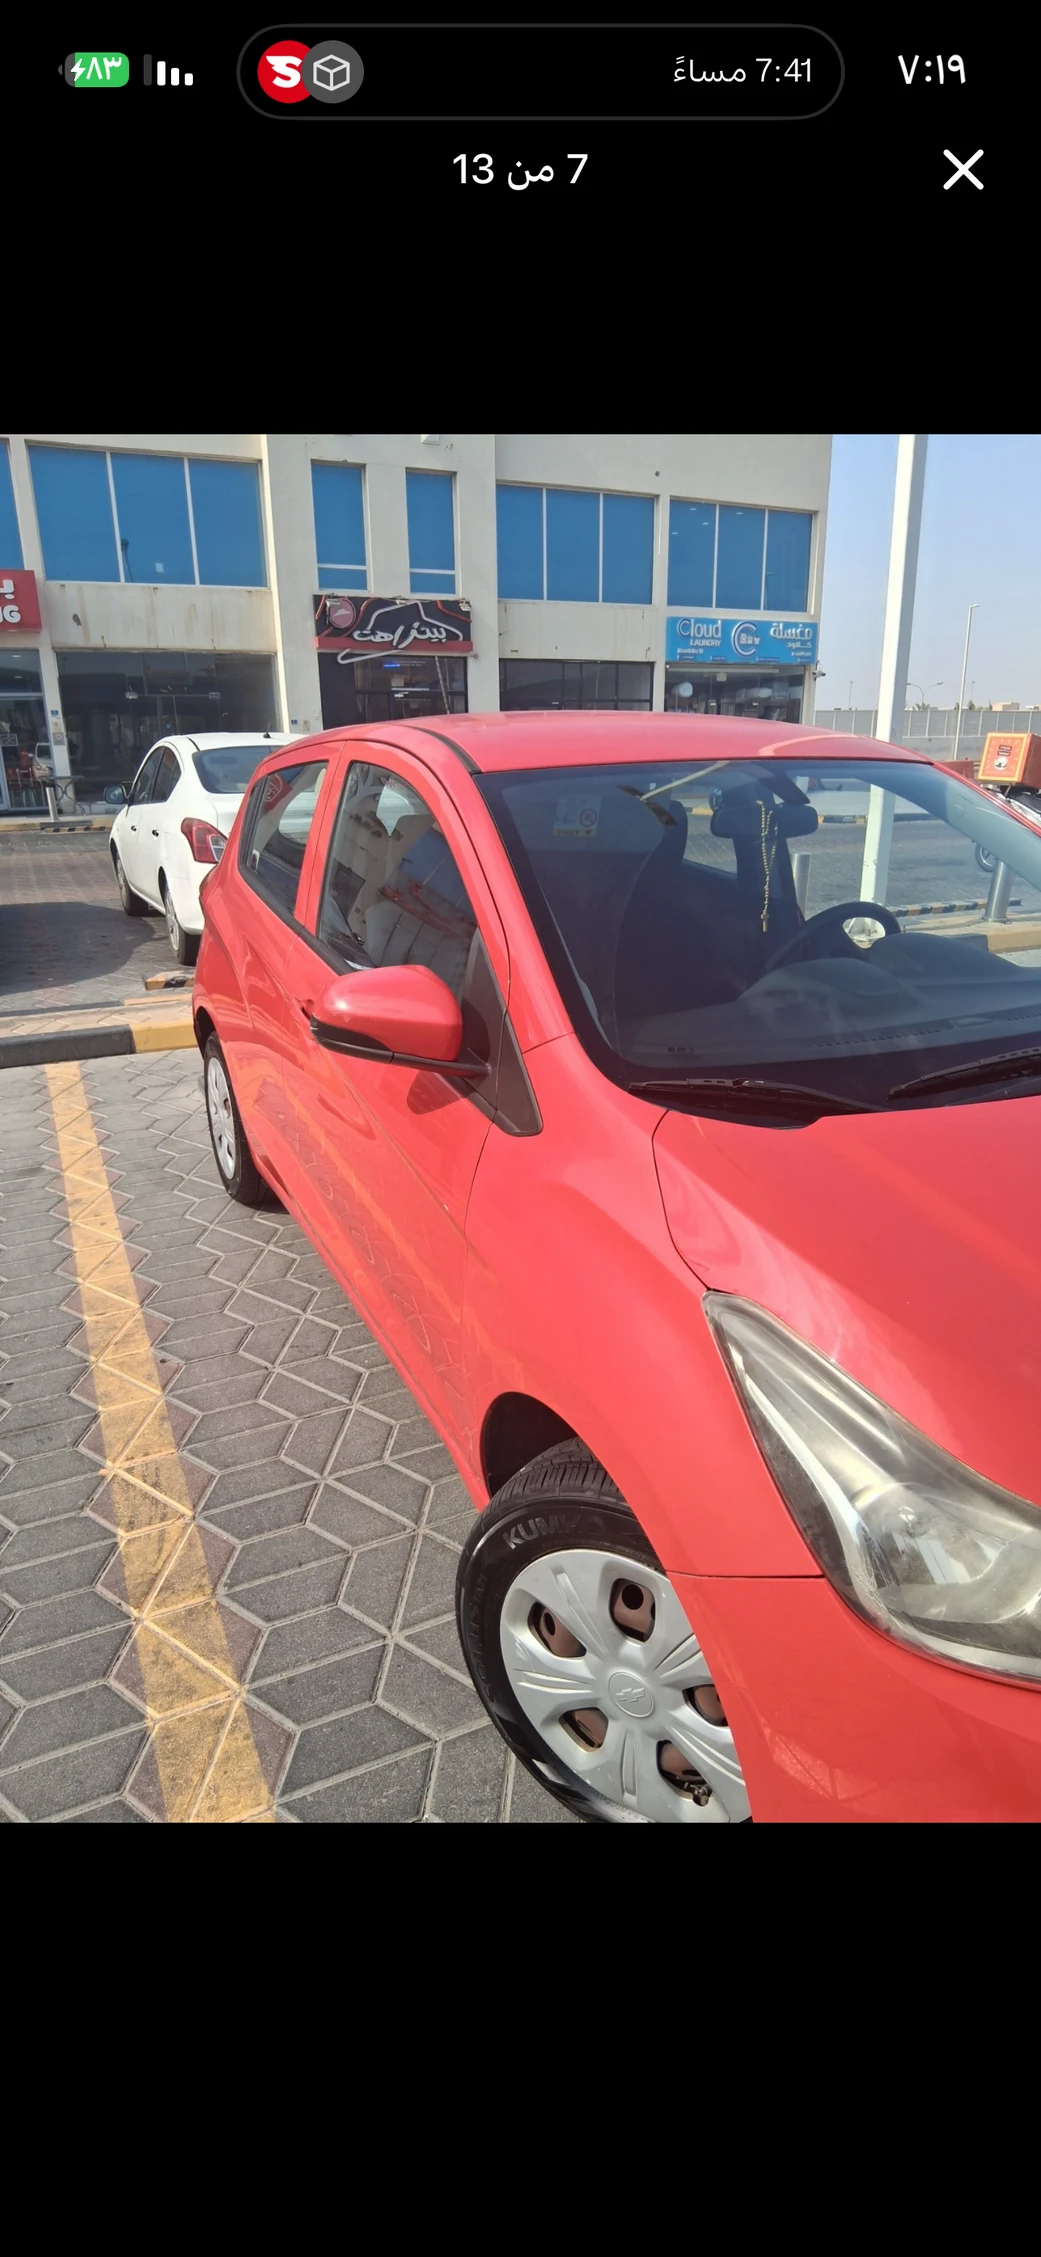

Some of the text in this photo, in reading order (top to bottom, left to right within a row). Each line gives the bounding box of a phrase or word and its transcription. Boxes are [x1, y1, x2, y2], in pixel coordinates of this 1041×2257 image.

[677, 619, 721, 638] Cloud
[770, 622, 813, 640] مغسلة
[690, 638, 721, 647] LAUNDRY
